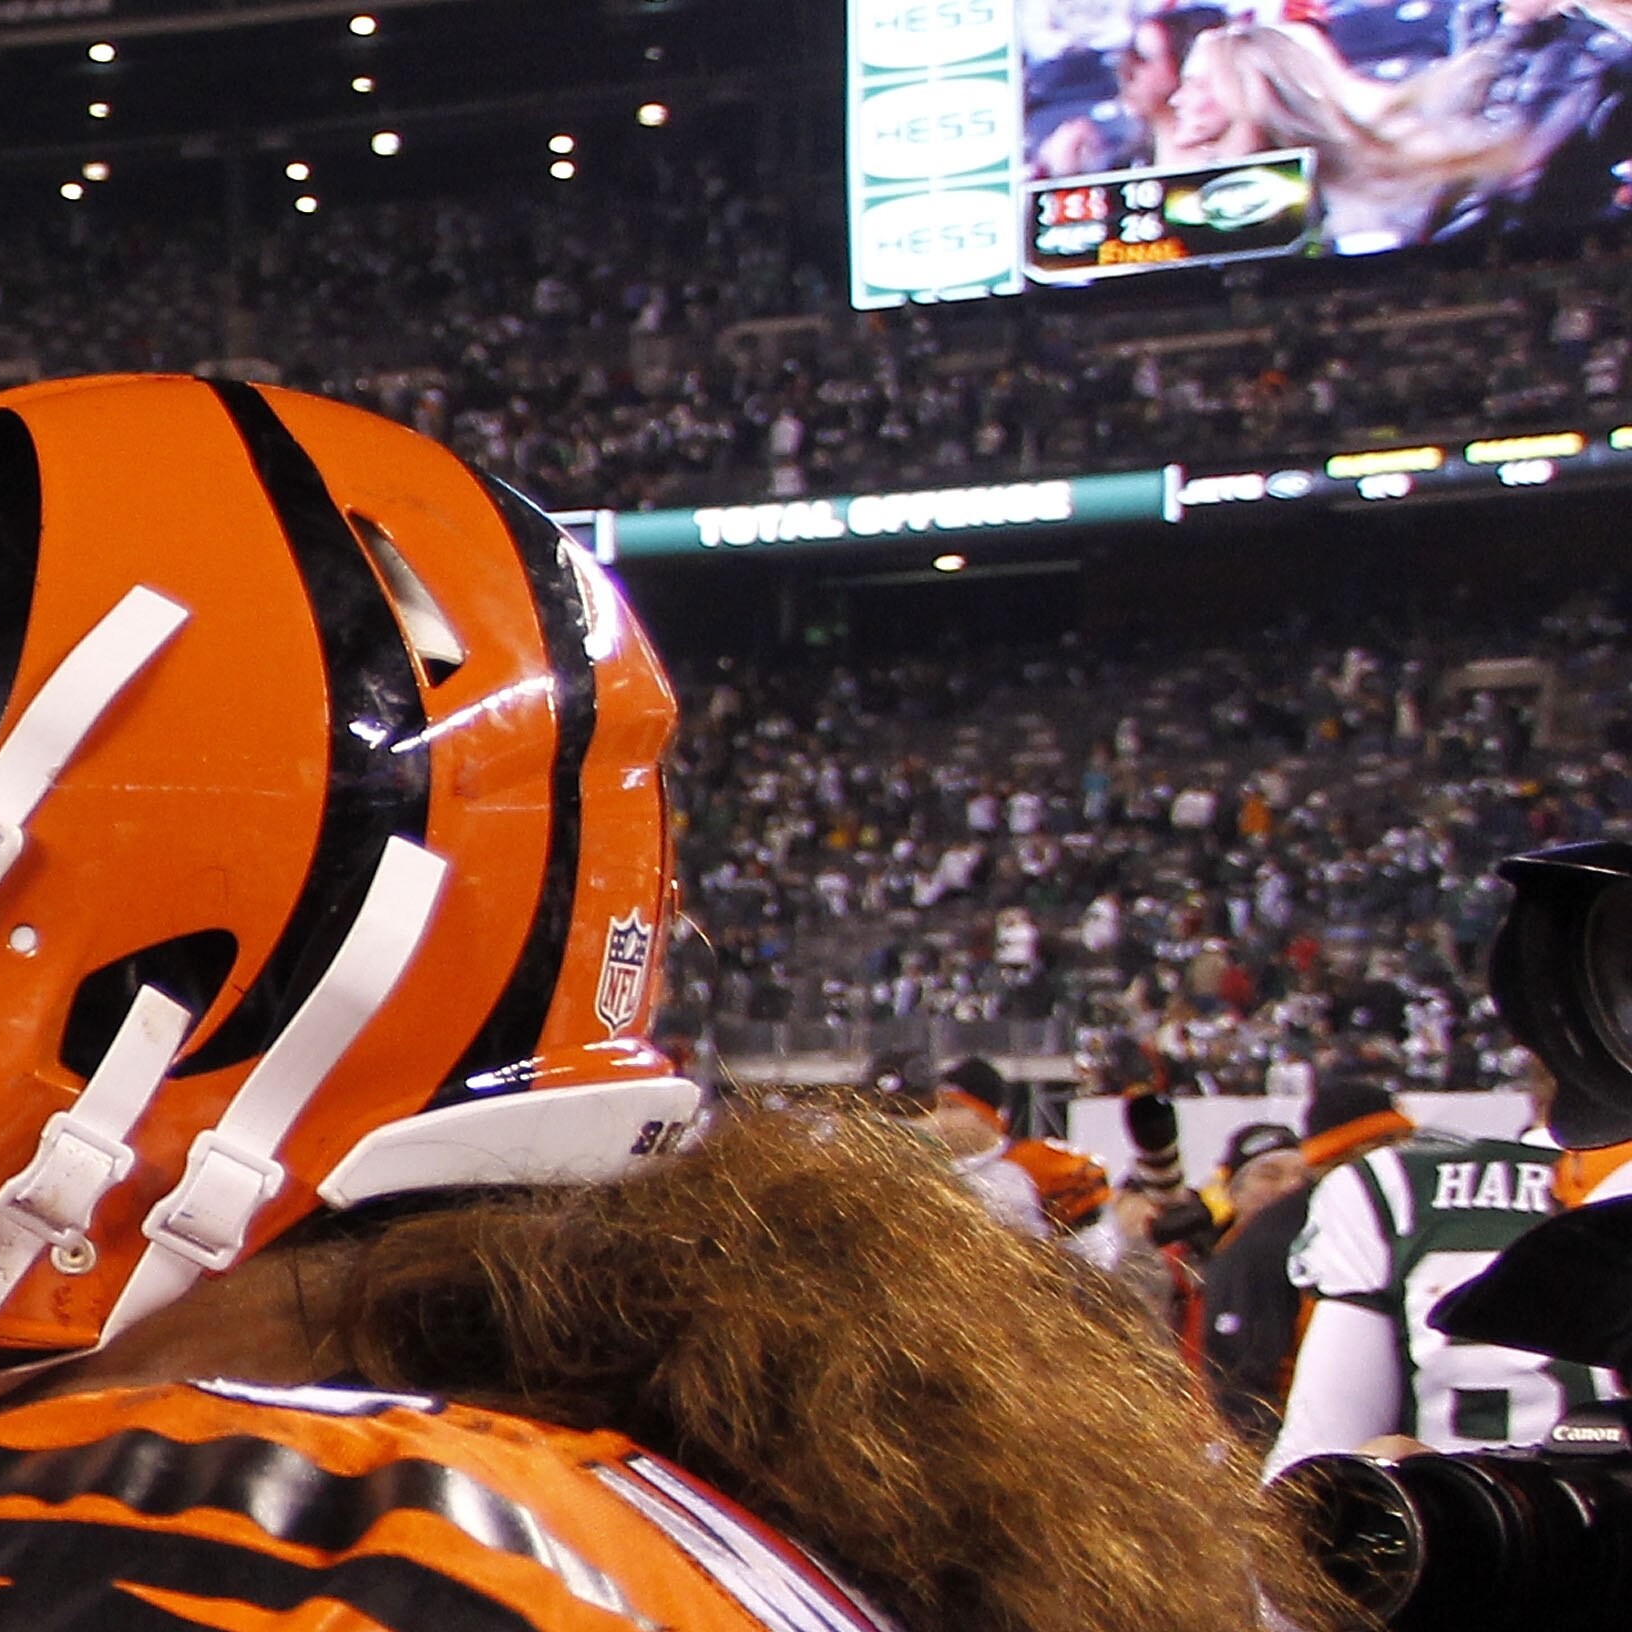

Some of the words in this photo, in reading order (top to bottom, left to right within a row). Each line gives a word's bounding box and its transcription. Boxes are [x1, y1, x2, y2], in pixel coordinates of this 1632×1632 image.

[876, 108, 996, 144] HESS
[878, 220, 997, 255] HESS
[693, 499, 845, 548] TOTAL
[1552, 1425, 1622, 1441] Canon
